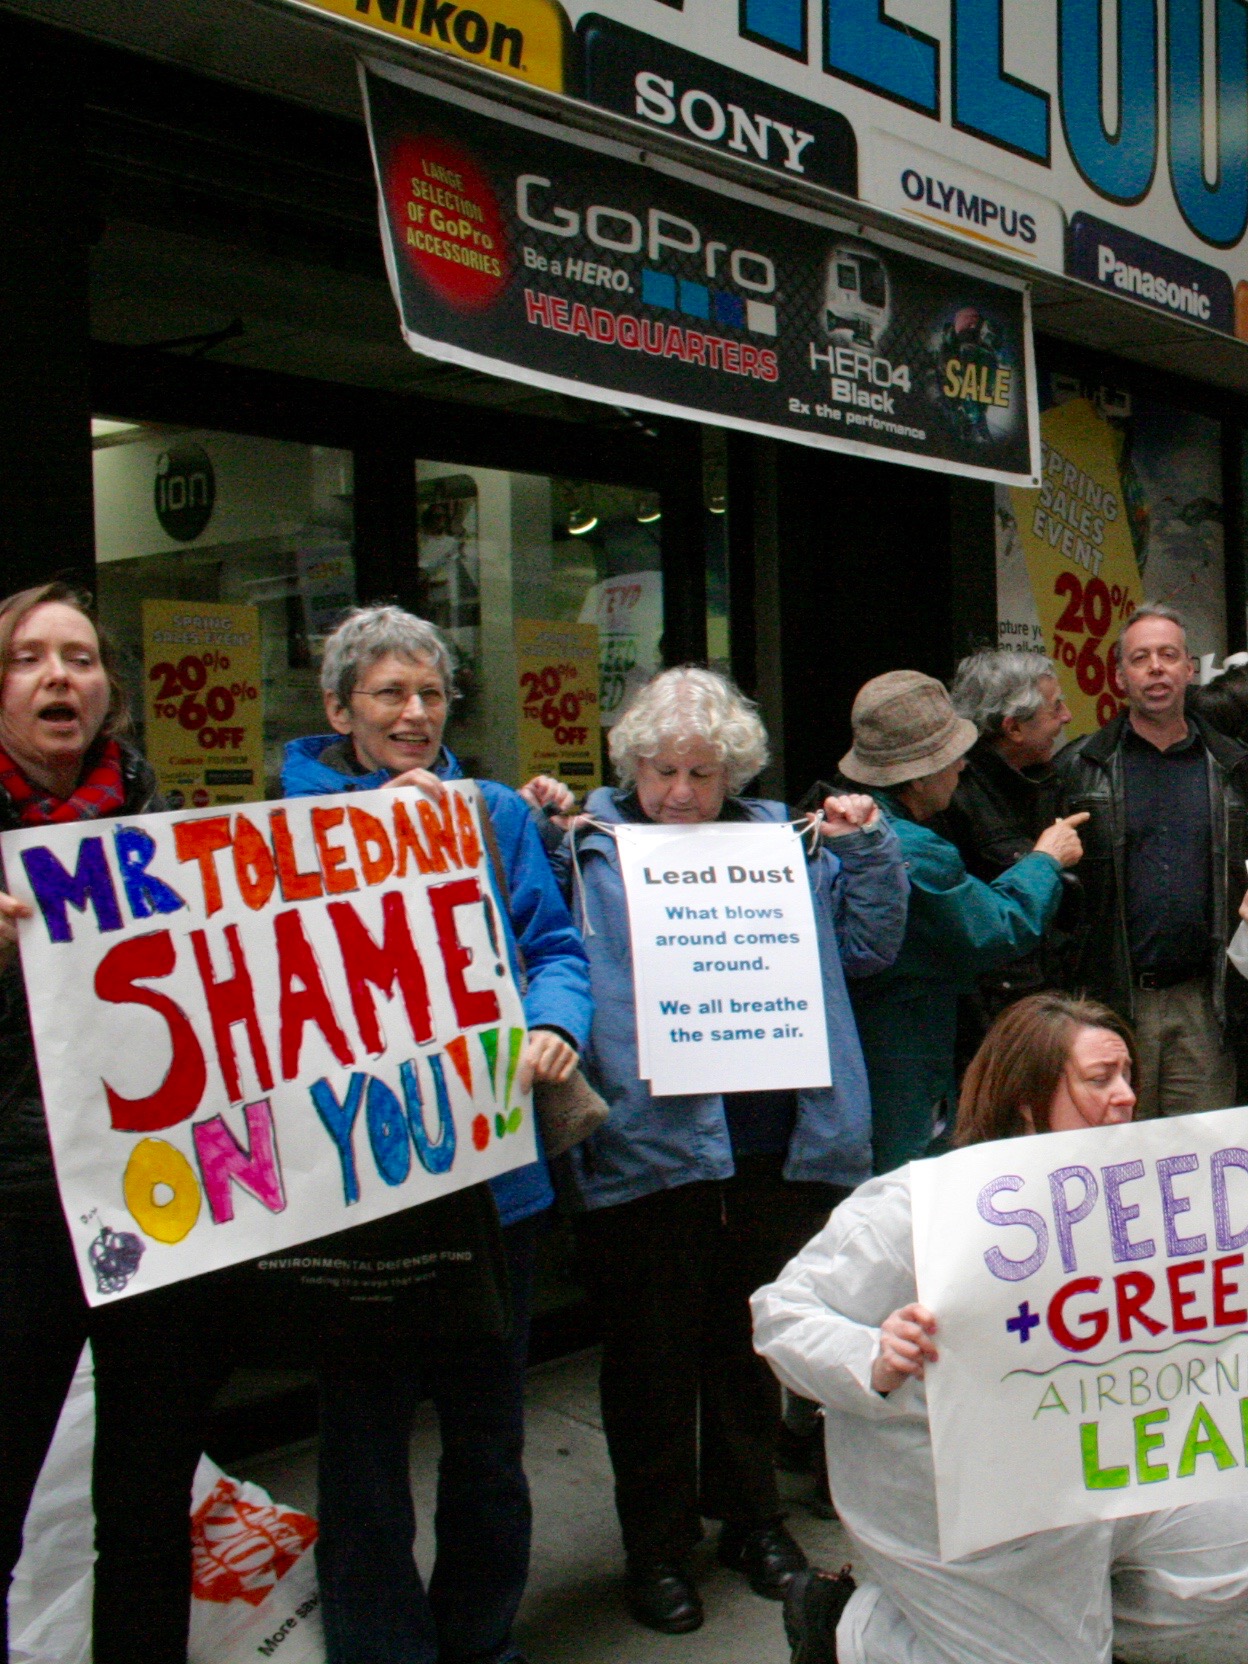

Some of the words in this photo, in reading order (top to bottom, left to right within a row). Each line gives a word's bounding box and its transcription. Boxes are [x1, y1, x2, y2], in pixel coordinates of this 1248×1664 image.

[634, 70, 815, 174] SONY
[421, 159, 465, 192] LARGE
[411, 177, 484, 223] SELECTION
[901, 168, 1037, 244] OLYMPUS
[407, 201, 426, 222] OF
[429, 205, 494, 249] GoPro
[516, 174, 776, 294] GoPro
[406, 228, 501, 277] ACCESSORIES
[523, 246, 548, 271] Be
[550, 258, 562, 275] a
[565, 257, 634, 294] HERO.
[1098, 244, 1211, 321] Panasonic
[524, 288, 779, 382] HEADQUARTERS
[810, 342, 912, 393] HERO4
[943, 358, 1012, 409] SALE
[788, 398, 811, 415] 2x
[815, 402, 842, 421] the
[846, 412, 927, 440] performance
[831, 377, 895, 415] Black
[160, 453, 208, 513] ion
[1040, 480, 1105, 546] SALES
[1033, 508, 1103, 577] EVENT
[1054, 572, 1136, 637] 20%
[1053, 634, 1076, 668] TO
[150, 650, 230, 701] 20%
[520, 663, 578, 704] 20%
[154, 704, 178, 719] TO
[178, 680, 258, 731] 60%
[541, 687, 597, 729] 60%
[198, 727, 245, 749] OFF
[554, 726, 589, 745] OFF
[20, 823, 187, 943] MR
[171, 790, 484, 918] TOLEDANO
[643, 865, 717, 884] Lead
[728, 865, 794, 884] Dust
[665, 905, 718, 920] What
[726, 905, 784, 920] blows
[656, 931, 727, 946] around
[734, 931, 800, 945] comes
[693, 957, 770, 972] around.
[659, 999, 691, 1015] We
[699, 999, 723, 1014] all
[730, 997, 808, 1013] breathe
[670, 1027, 703, 1043] the
[711, 1026, 766, 1041] same
[773, 1023, 804, 1039] air.
[123, 1098, 287, 1245] ON
[440, 1251, 472, 1262] FUND
[257, 1614, 298, 1657] More
